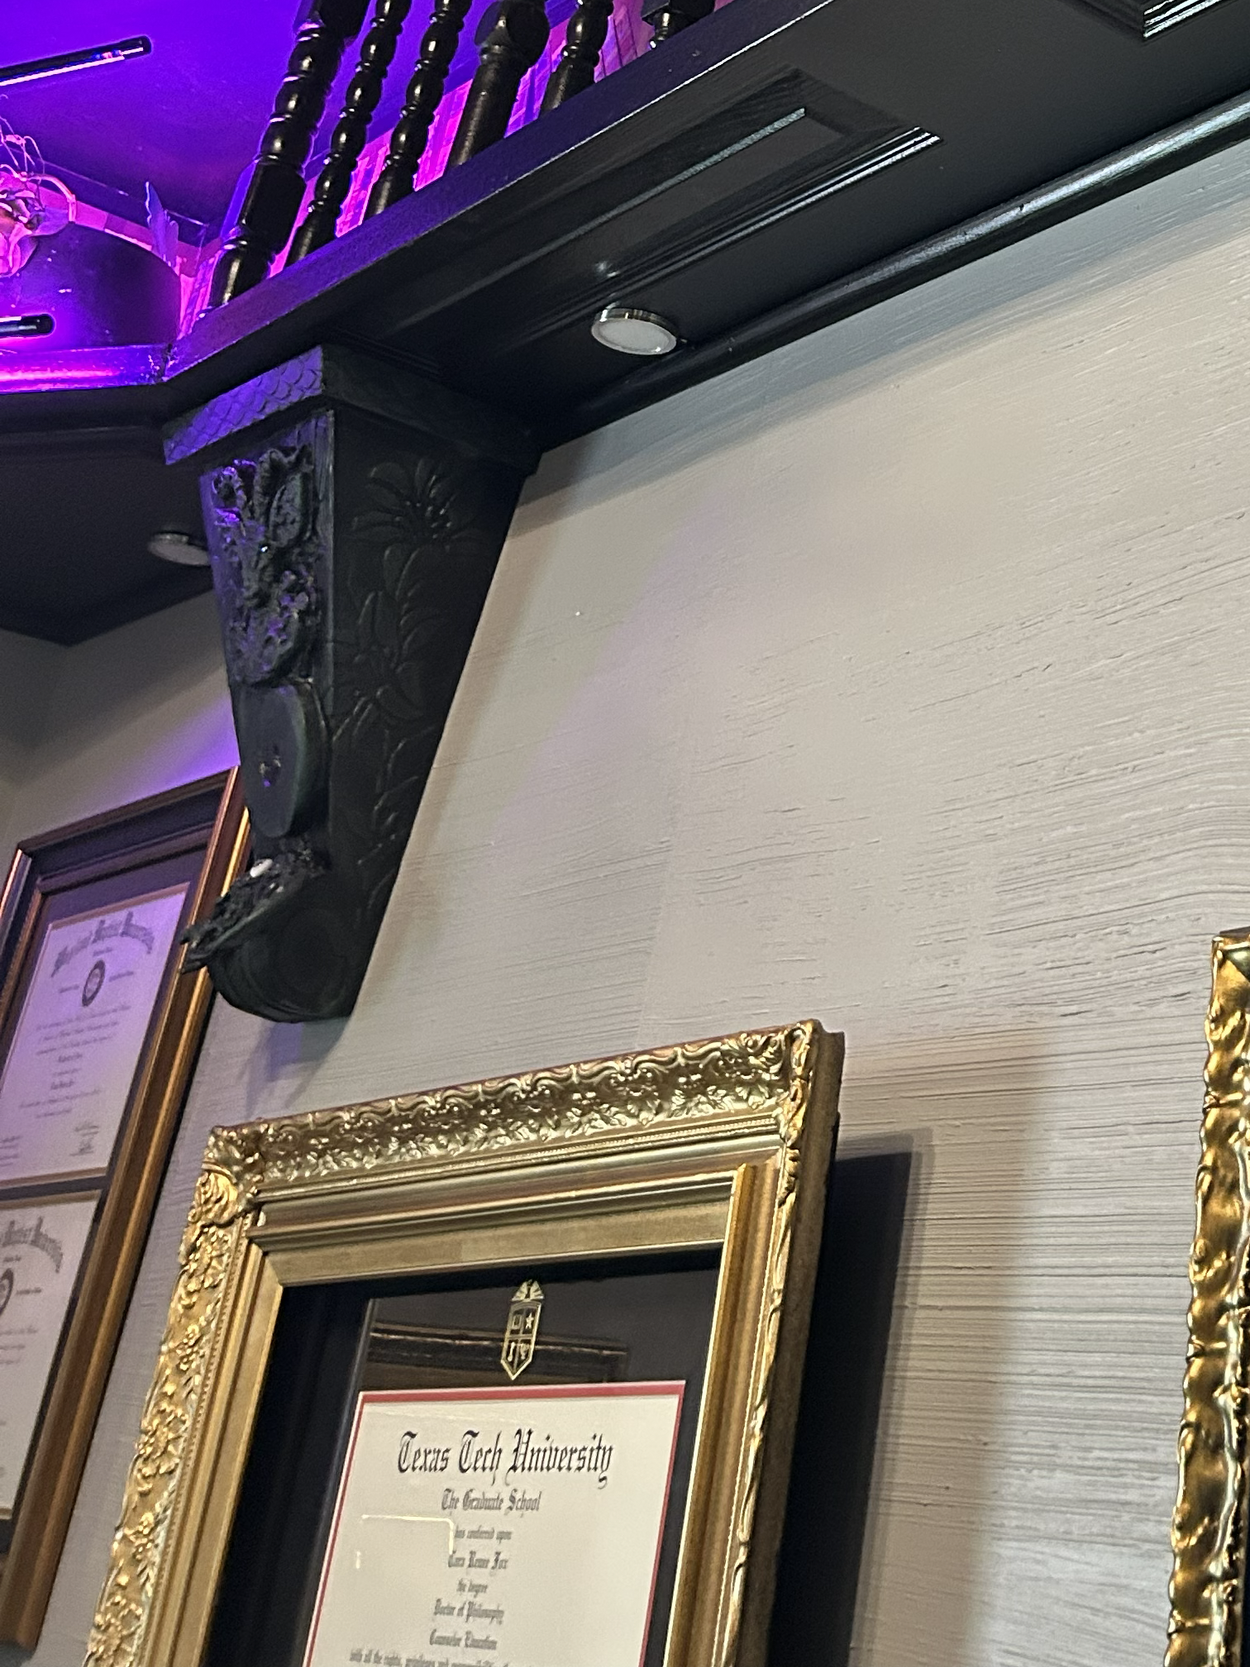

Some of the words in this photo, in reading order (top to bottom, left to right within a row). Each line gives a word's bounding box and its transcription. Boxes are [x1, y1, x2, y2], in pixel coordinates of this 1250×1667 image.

[398, 1430, 452, 1474] Texas
[458, 1429, 503, 1486] Tech
[504, 1427, 614, 1490] University
[441, 1487, 459, 1513] The
[462, 1488, 504, 1512] Graduate
[504, 1488, 543, 1518] School
[433, 1598, 456, 1616] Doctor
[465, 1601, 505, 1625] Philosophy
